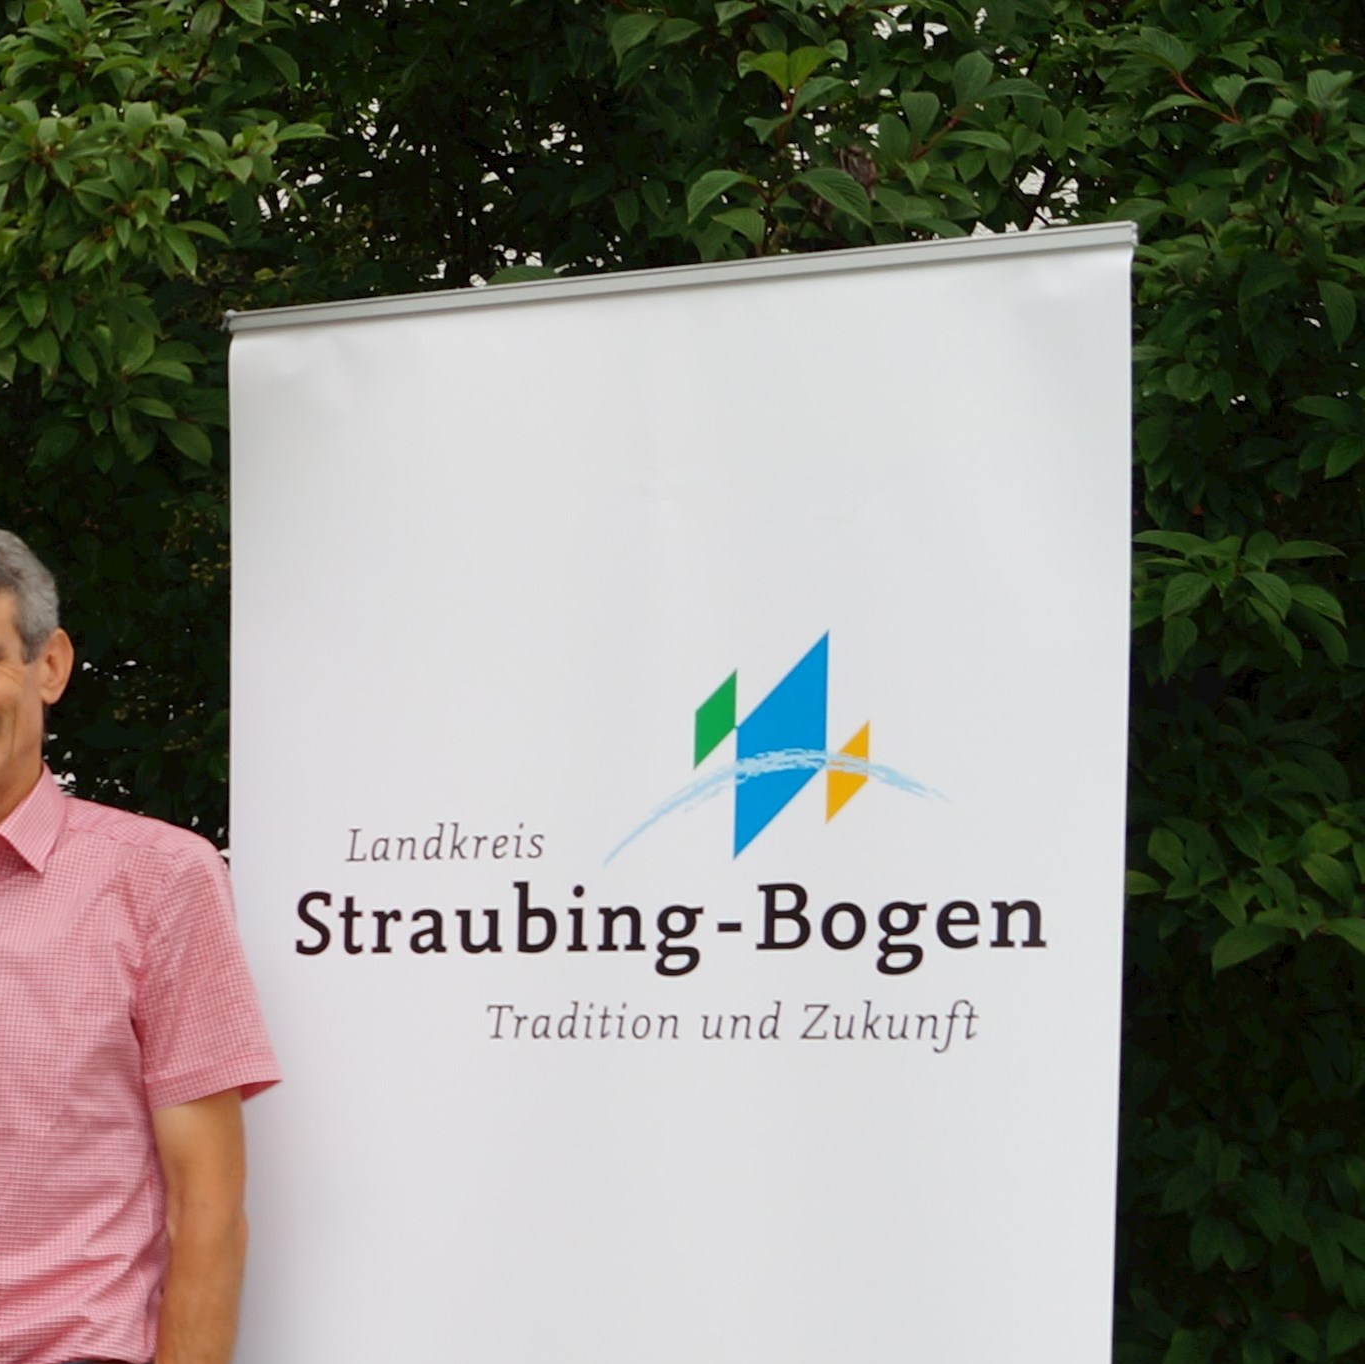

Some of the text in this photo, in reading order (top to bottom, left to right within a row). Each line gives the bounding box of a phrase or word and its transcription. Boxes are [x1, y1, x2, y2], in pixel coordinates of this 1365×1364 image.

[344, 821, 547, 865] Landkreis
[294, 880, 1048, 977] Straubing-Bogen
[485, 999, 981, 1055] Tradition und Zukunft
